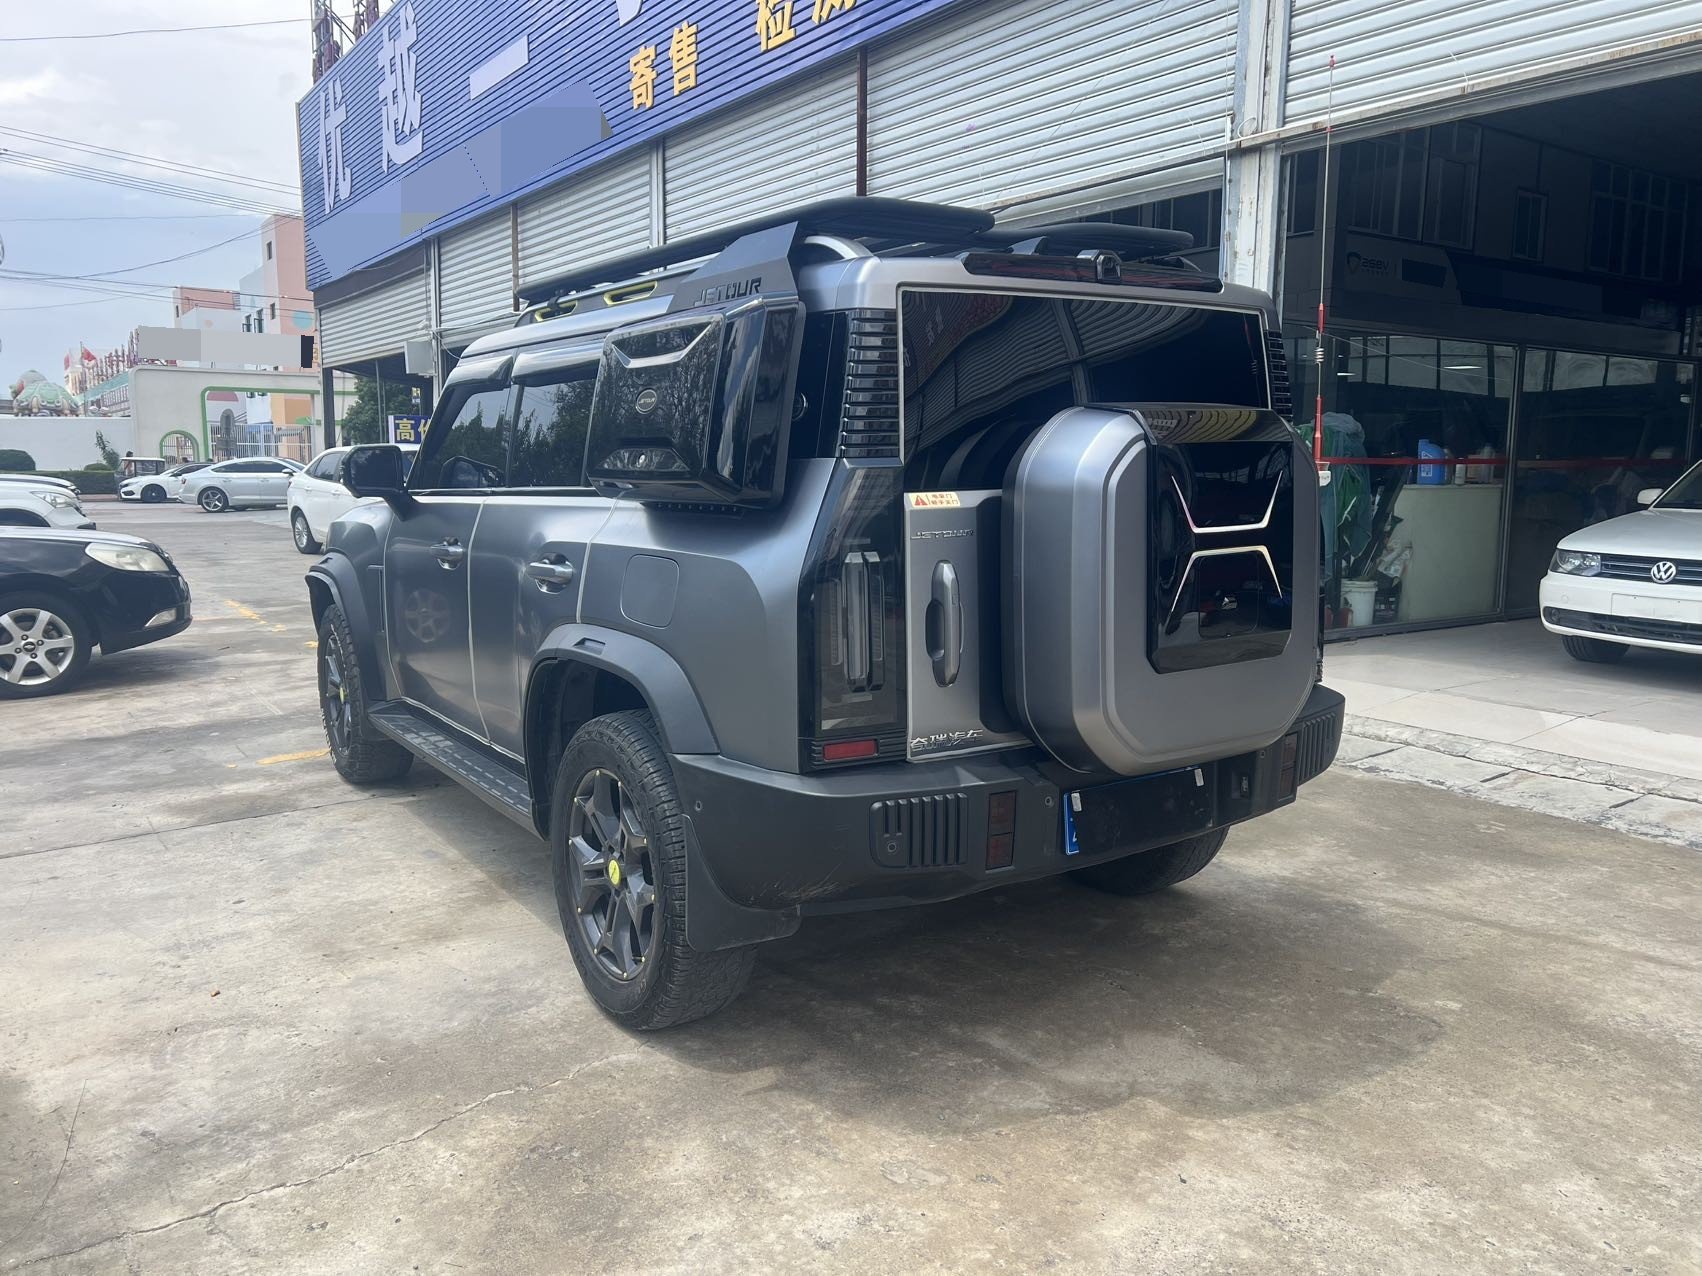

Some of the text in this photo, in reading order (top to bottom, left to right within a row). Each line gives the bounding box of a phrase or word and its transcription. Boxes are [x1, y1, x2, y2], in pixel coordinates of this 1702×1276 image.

[629, 0, 857, 110] 寄售 检
[693, 276, 762, 307] JETOUR
